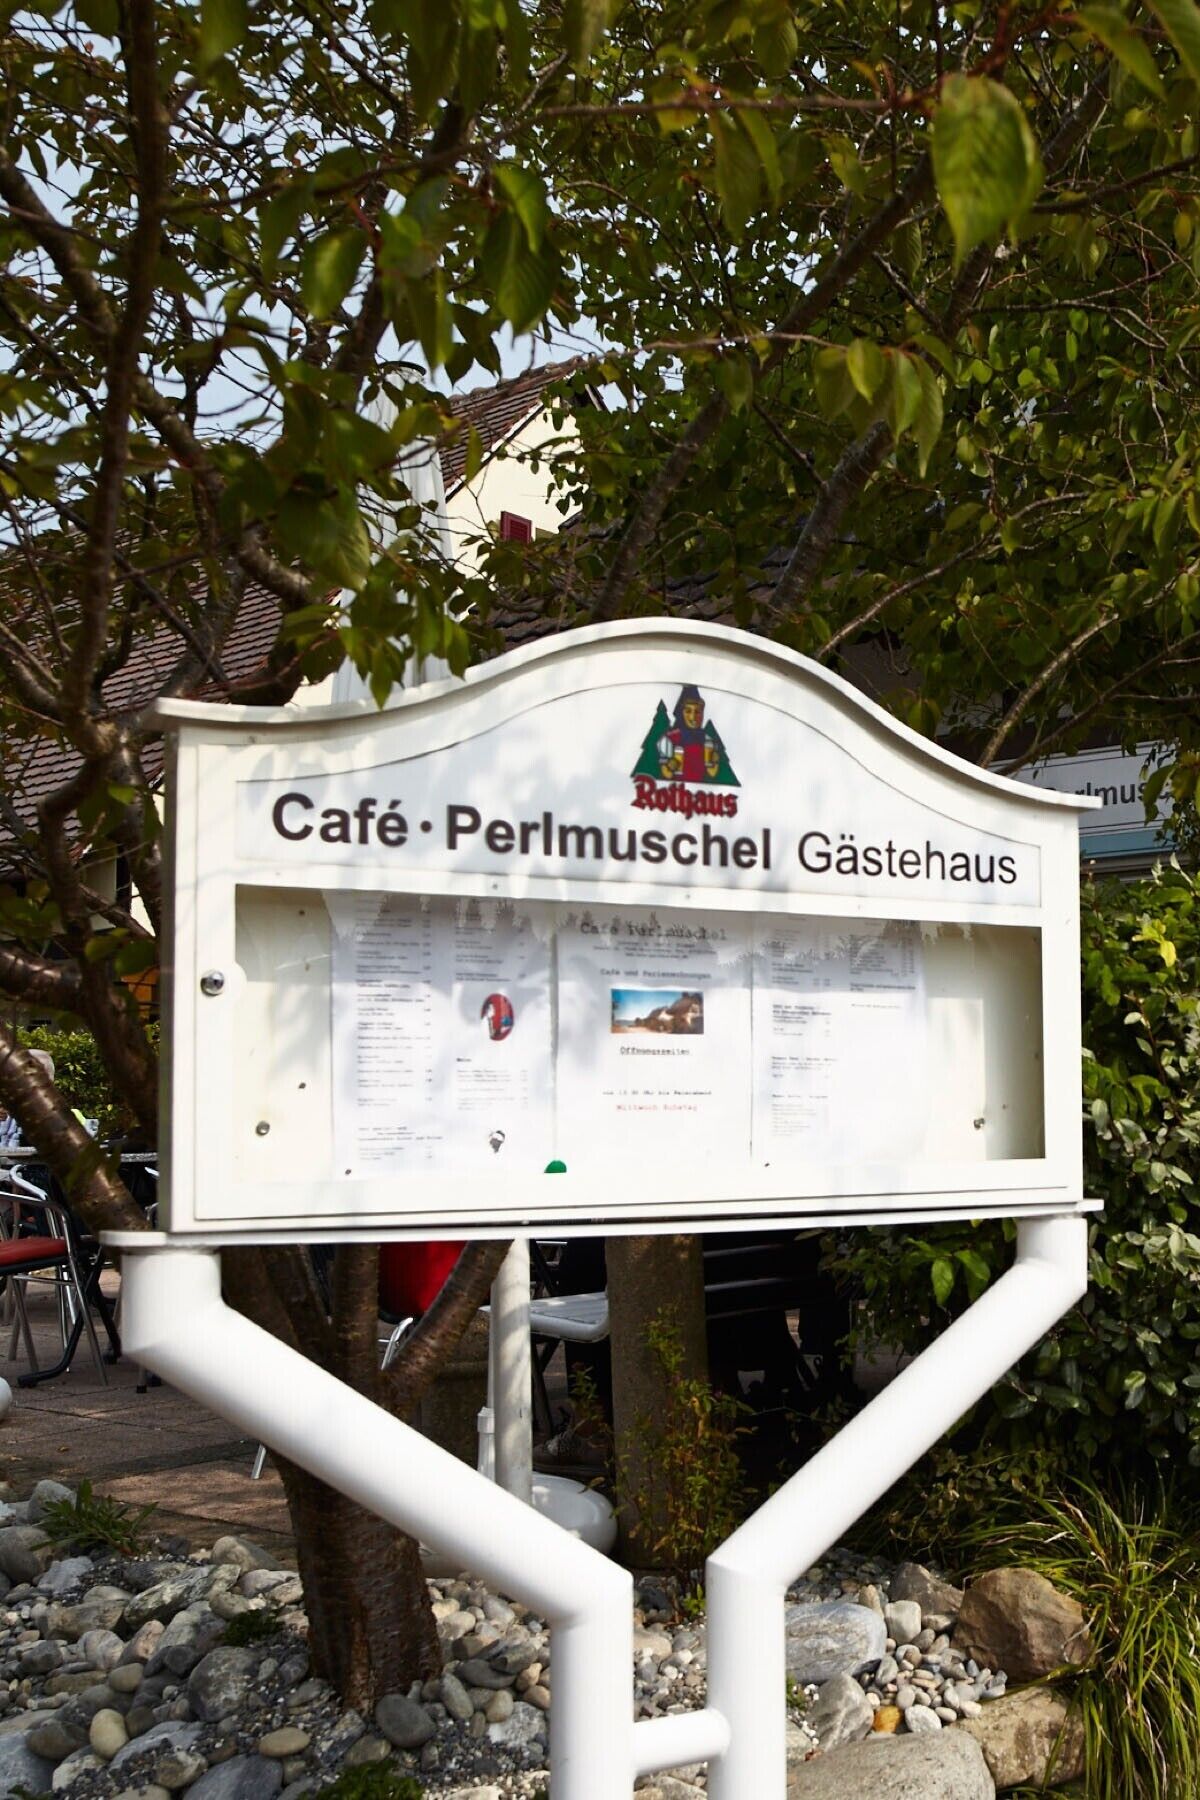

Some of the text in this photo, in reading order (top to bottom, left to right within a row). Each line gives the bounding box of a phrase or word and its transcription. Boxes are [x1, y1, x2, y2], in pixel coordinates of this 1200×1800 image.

[630, 773, 738, 820] Rothaus
[272, 792, 1017, 884] Café Perlmuschel Gästehaus
